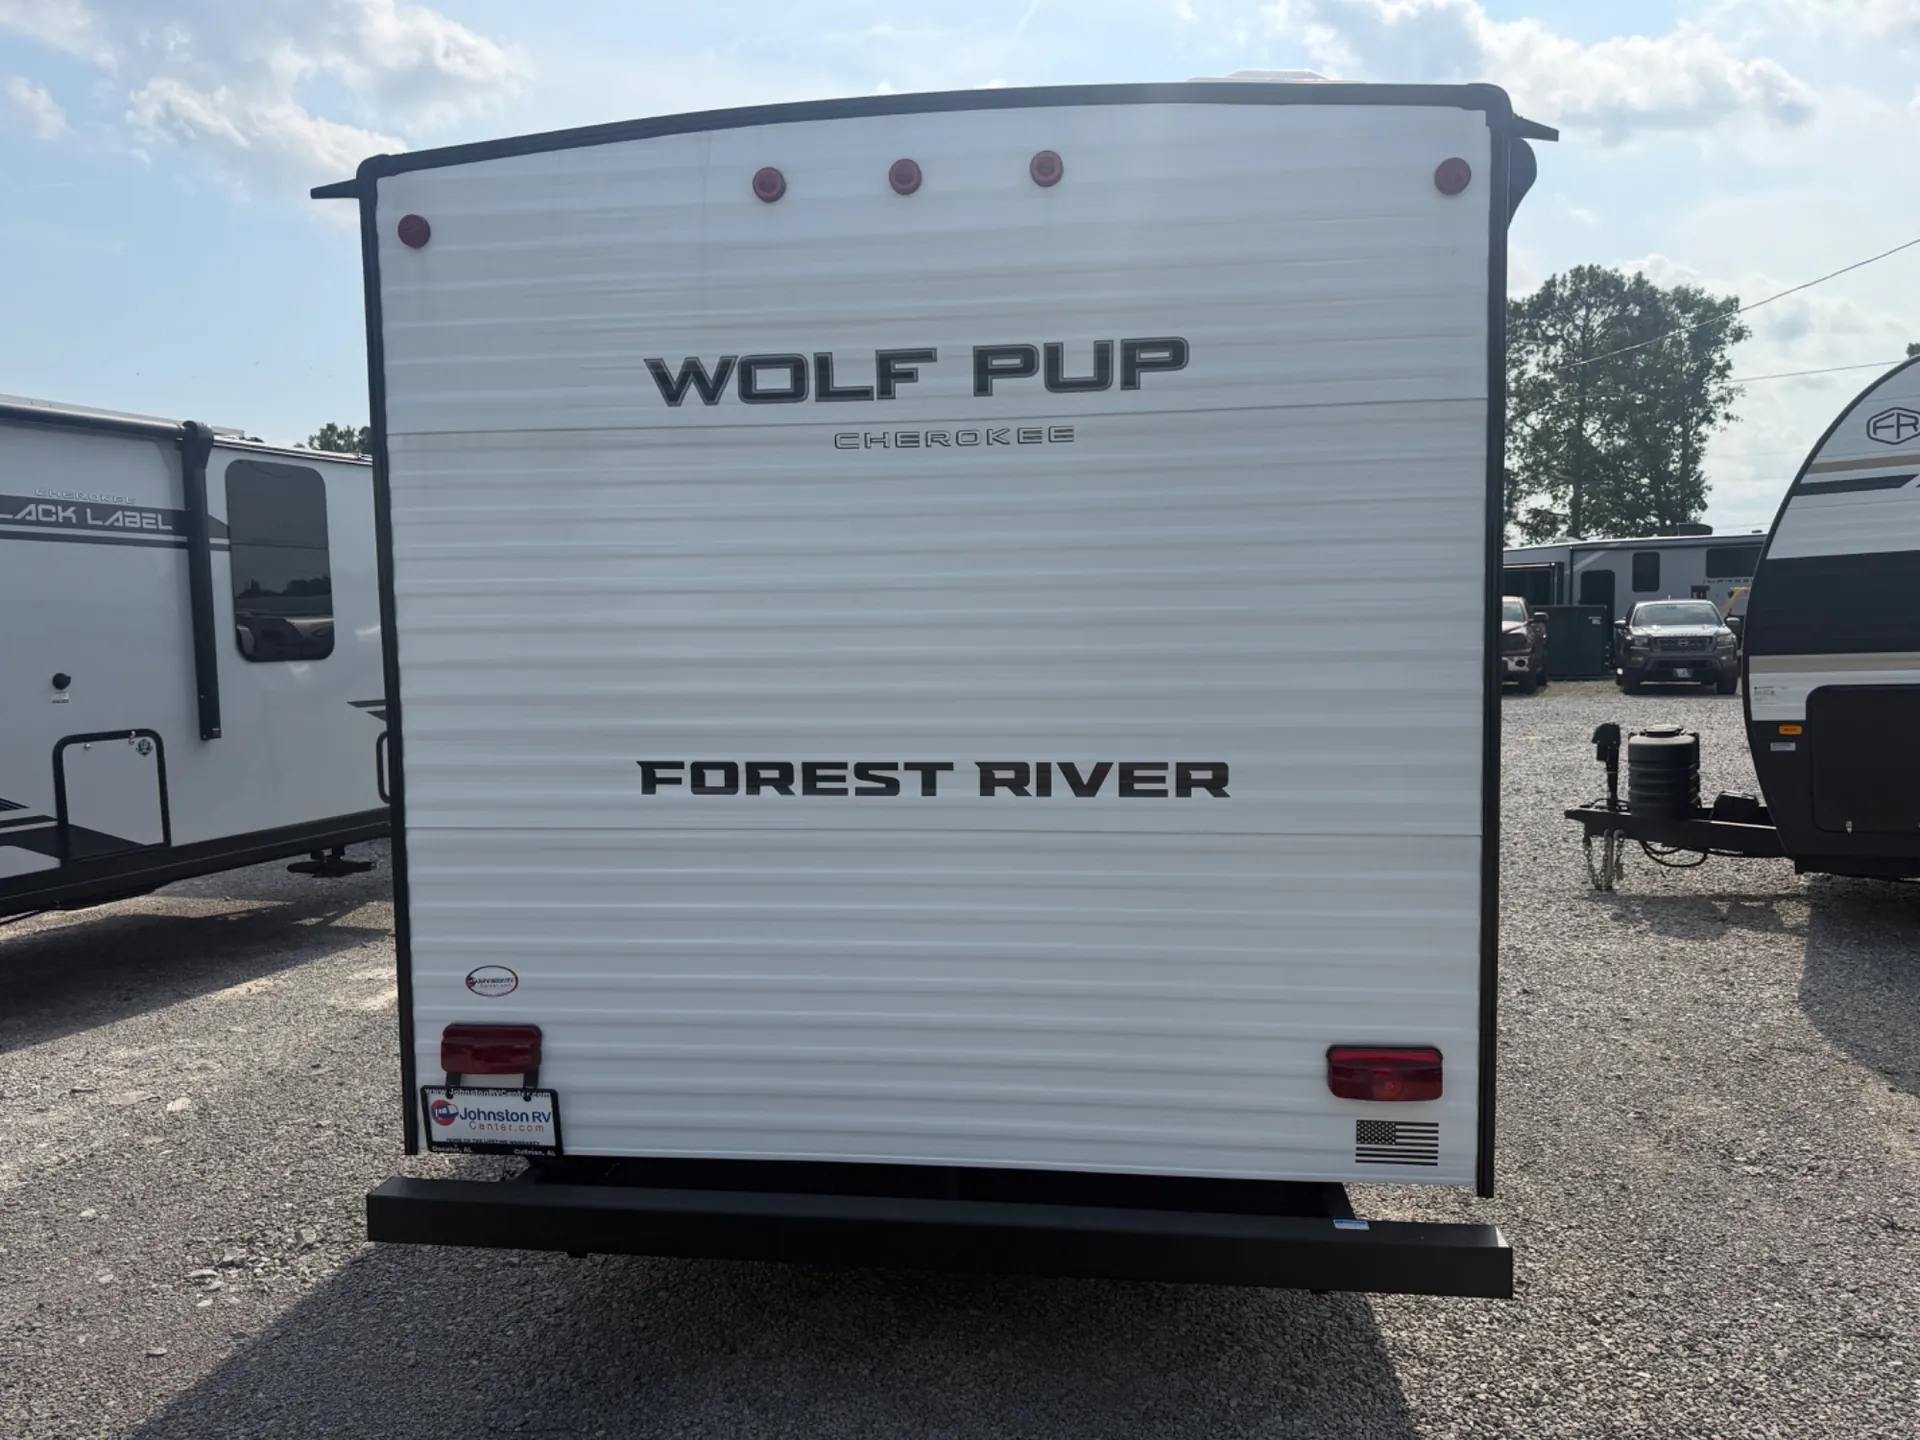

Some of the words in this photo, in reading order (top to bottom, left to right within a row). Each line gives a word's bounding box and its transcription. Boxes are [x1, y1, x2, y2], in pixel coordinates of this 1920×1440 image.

[643, 347, 938, 407] WOLF
[972, 336, 1190, 397] PUP
[834, 425, 1075, 450] CHEROKEE
[34, 486, 137, 505] CHEROKEE
[86, 507, 173, 531] LABEL
[636, 760, 954, 797] FOREST
[974, 761, 1232, 798] RIVER
[459, 1107, 528, 1122] Johnston
[532, 1111, 552, 1124] RV
[469, 1120, 545, 1133] Center.com
